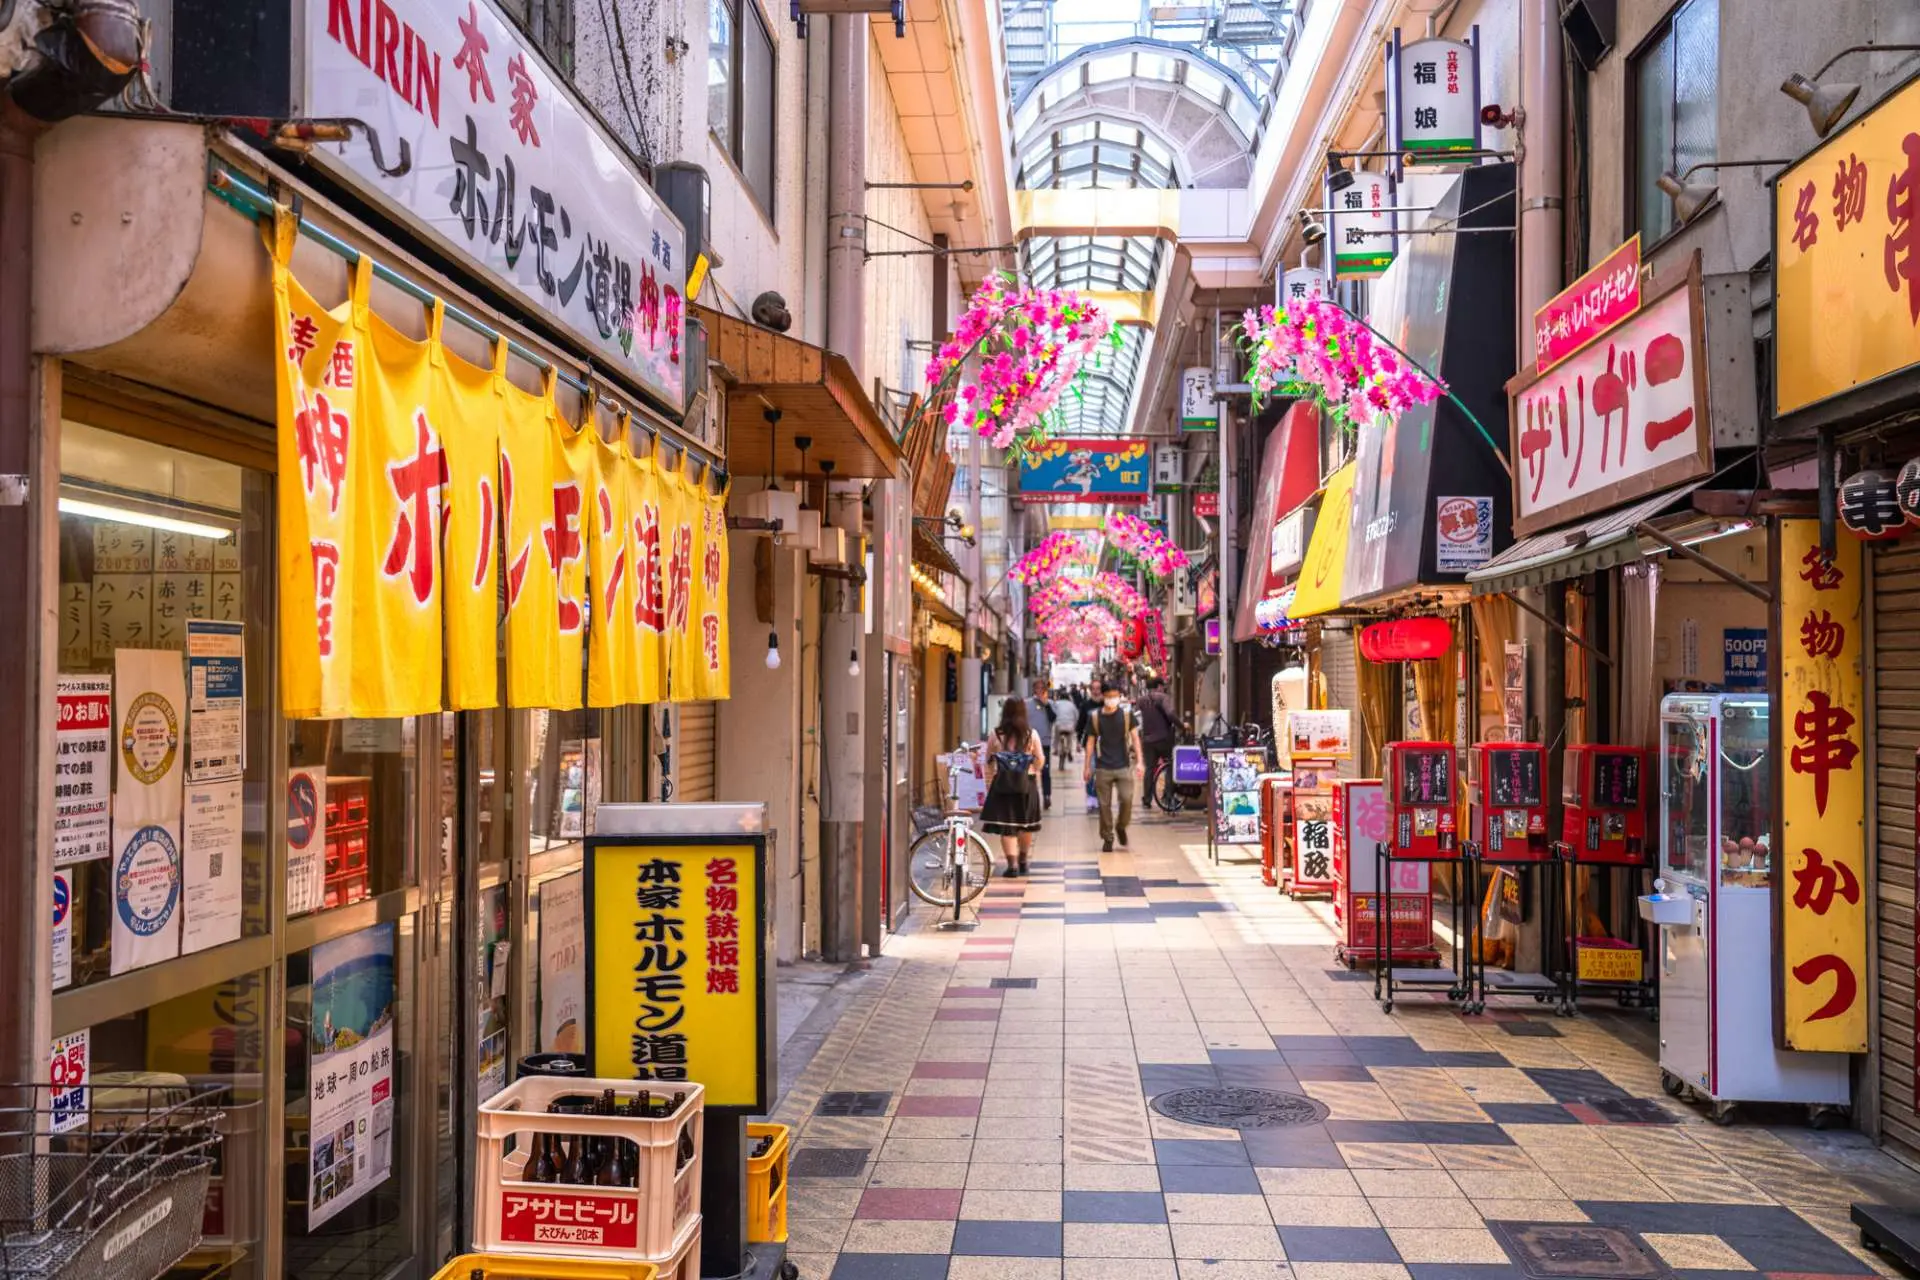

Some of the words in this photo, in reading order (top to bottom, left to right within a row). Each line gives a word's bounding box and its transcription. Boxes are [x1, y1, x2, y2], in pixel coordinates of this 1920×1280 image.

[326, 0, 441, 129] KIRIN
[453, 2, 541, 148] 本家
[1414, 62, 1437, 129] 福娘
[1792, 152, 1868, 253] 名物
[449, 114, 635, 359] ホルモン道場
[1521, 333, 1694, 504] ザリガニ
[382, 411, 693, 634] ホルモン道場
[1478, 501, 1490, 544] スタッフ
[68, 585, 86, 646] 上ミノ
[97, 582, 115, 638] ハラミ
[157, 580, 176, 638] 赤セン
[186, 579, 206, 618] 生セ
[1800, 546, 1845, 659] 名物
[1725, 639, 1767, 653] 500円
[1725, 670, 1767, 678] exchange
[1731, 655, 1758, 668] 両替
[1791, 690, 1860, 1023] 串かつ
[705, 857, 738, 994] 名物鉄板焼
[314, 1047, 390, 1100] 地球一周の船旅
[506, 1196, 634, 1225] アサヒビール
[538, 1226, 599, 1241] 大びん・20本
